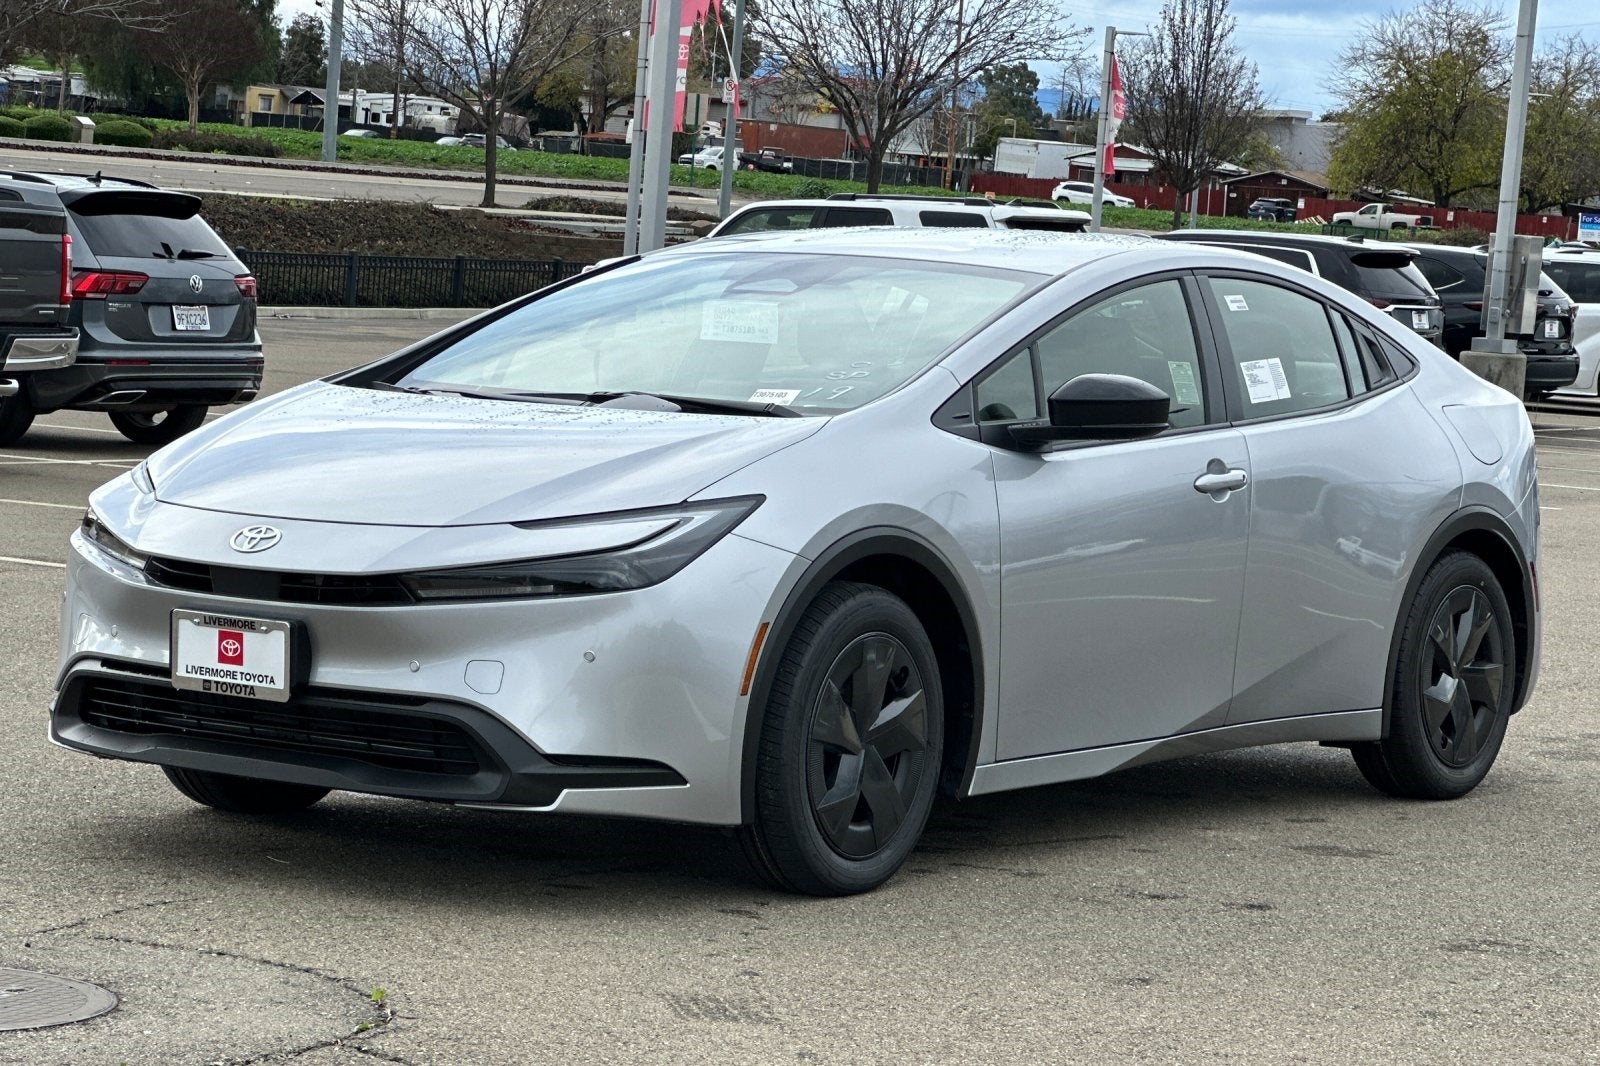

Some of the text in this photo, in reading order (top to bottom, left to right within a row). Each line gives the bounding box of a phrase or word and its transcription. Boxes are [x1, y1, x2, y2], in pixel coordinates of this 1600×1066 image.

[203, 615, 256, 630] LIVERMORE
[185, 664, 276, 685] LIVERMORE TOYOTA
[214, 681, 256, 697] TOYOTA
